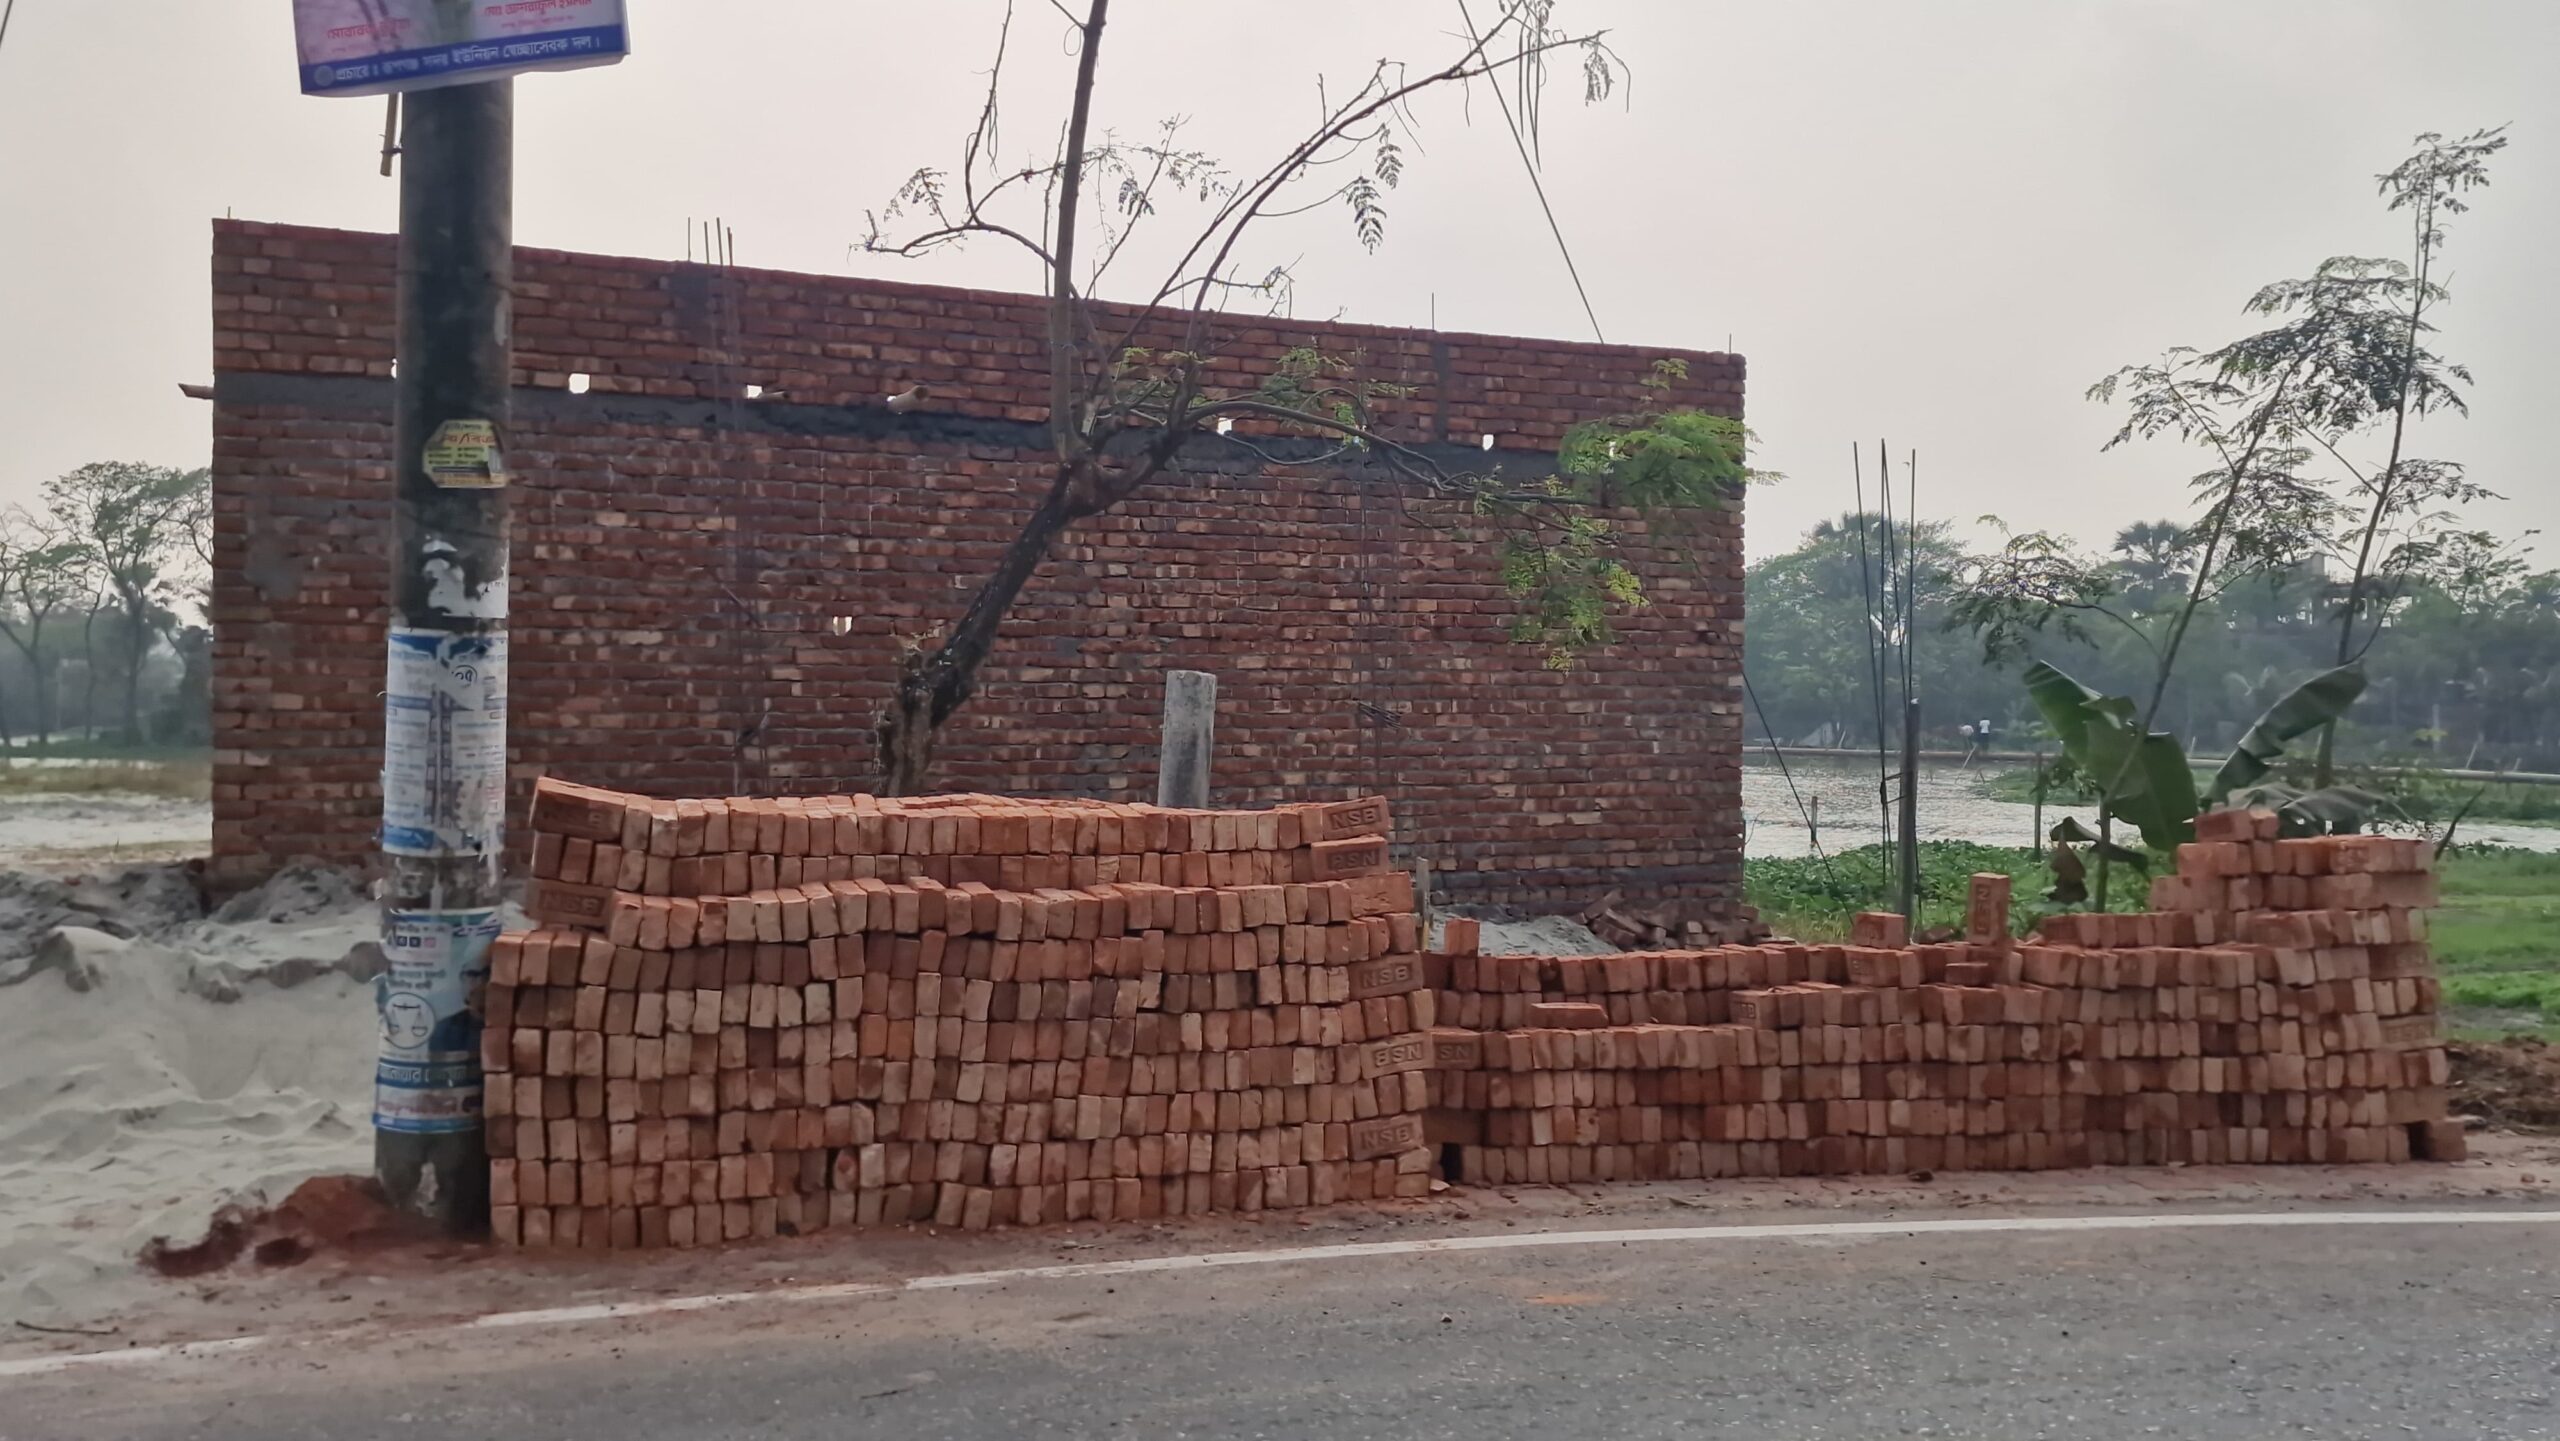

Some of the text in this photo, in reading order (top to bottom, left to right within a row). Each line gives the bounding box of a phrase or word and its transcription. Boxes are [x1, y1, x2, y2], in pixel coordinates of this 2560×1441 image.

[1332, 807, 1377, 829] NSB
[1362, 966, 1409, 988] NSB
[1361, 1127, 1410, 1150] NSB
